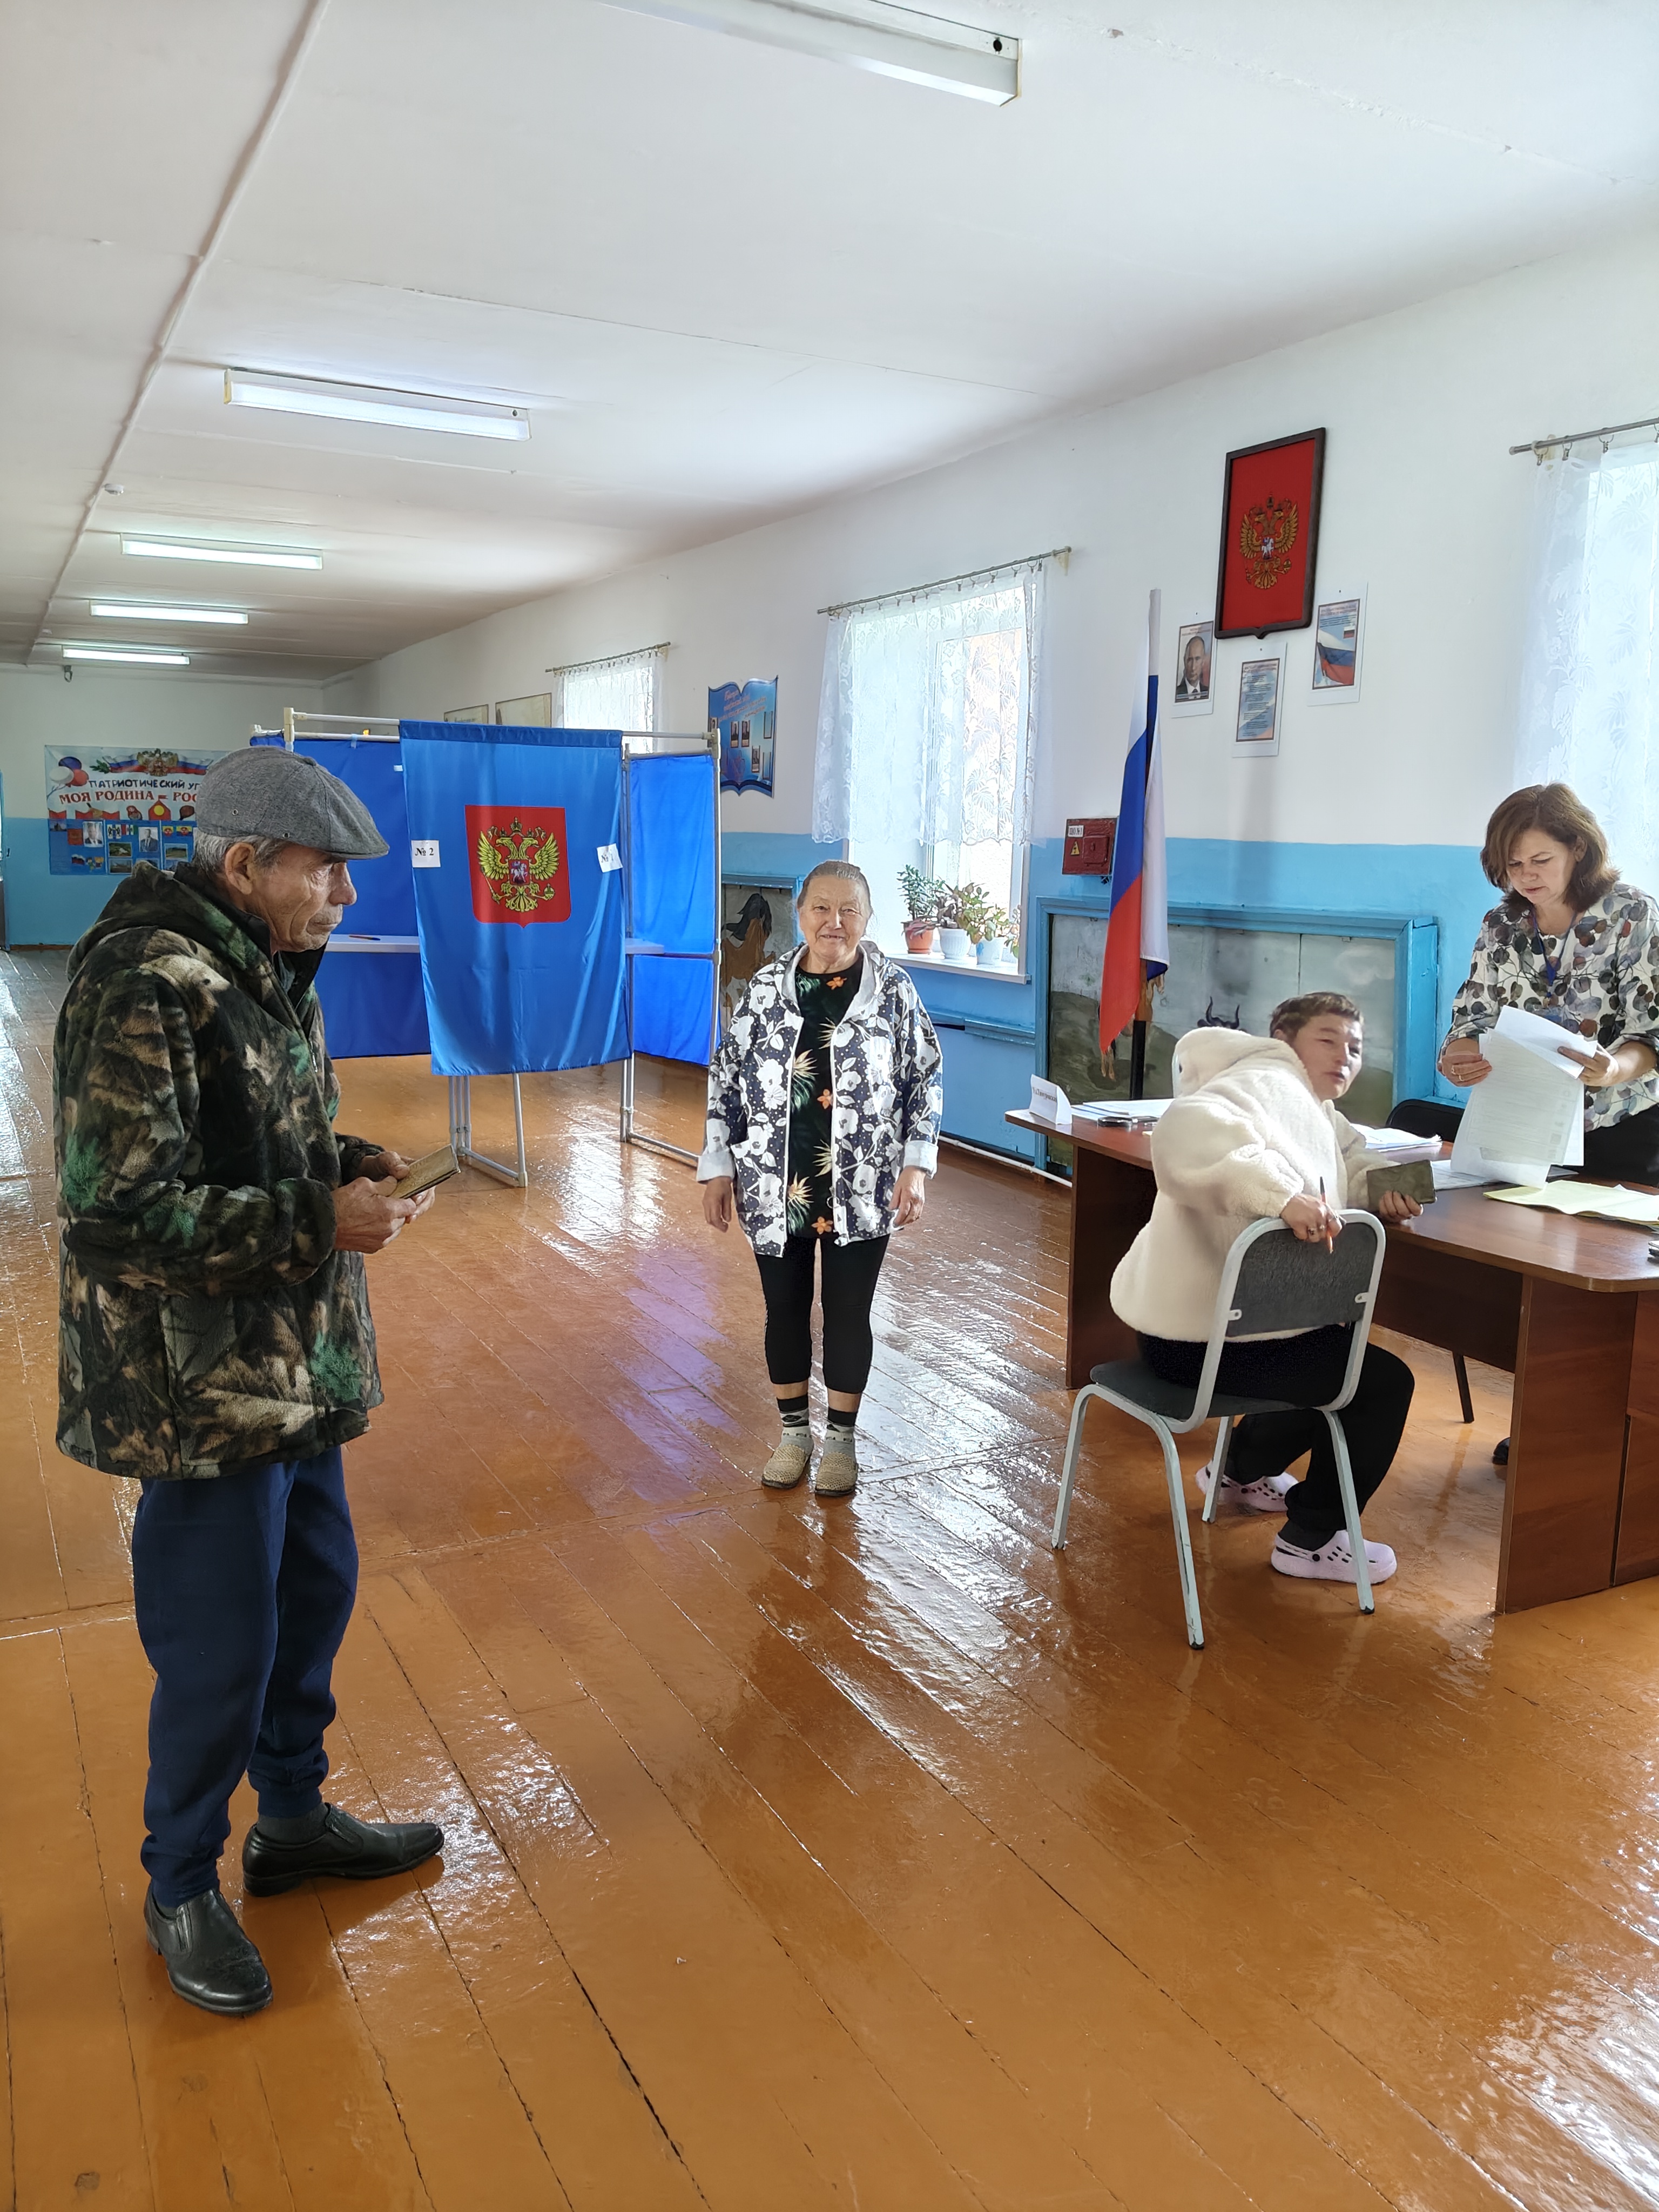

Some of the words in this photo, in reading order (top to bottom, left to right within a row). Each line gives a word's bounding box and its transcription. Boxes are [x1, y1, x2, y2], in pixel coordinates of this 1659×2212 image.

[89, 779, 185, 788] ПАТРИОТИЧЕСКИЙ
[59, 792, 91, 805] МОЯ
[95, 790, 154, 801] РОДИНА
[415, 847, 427, 856] №
[429, 847, 434, 856] 2
